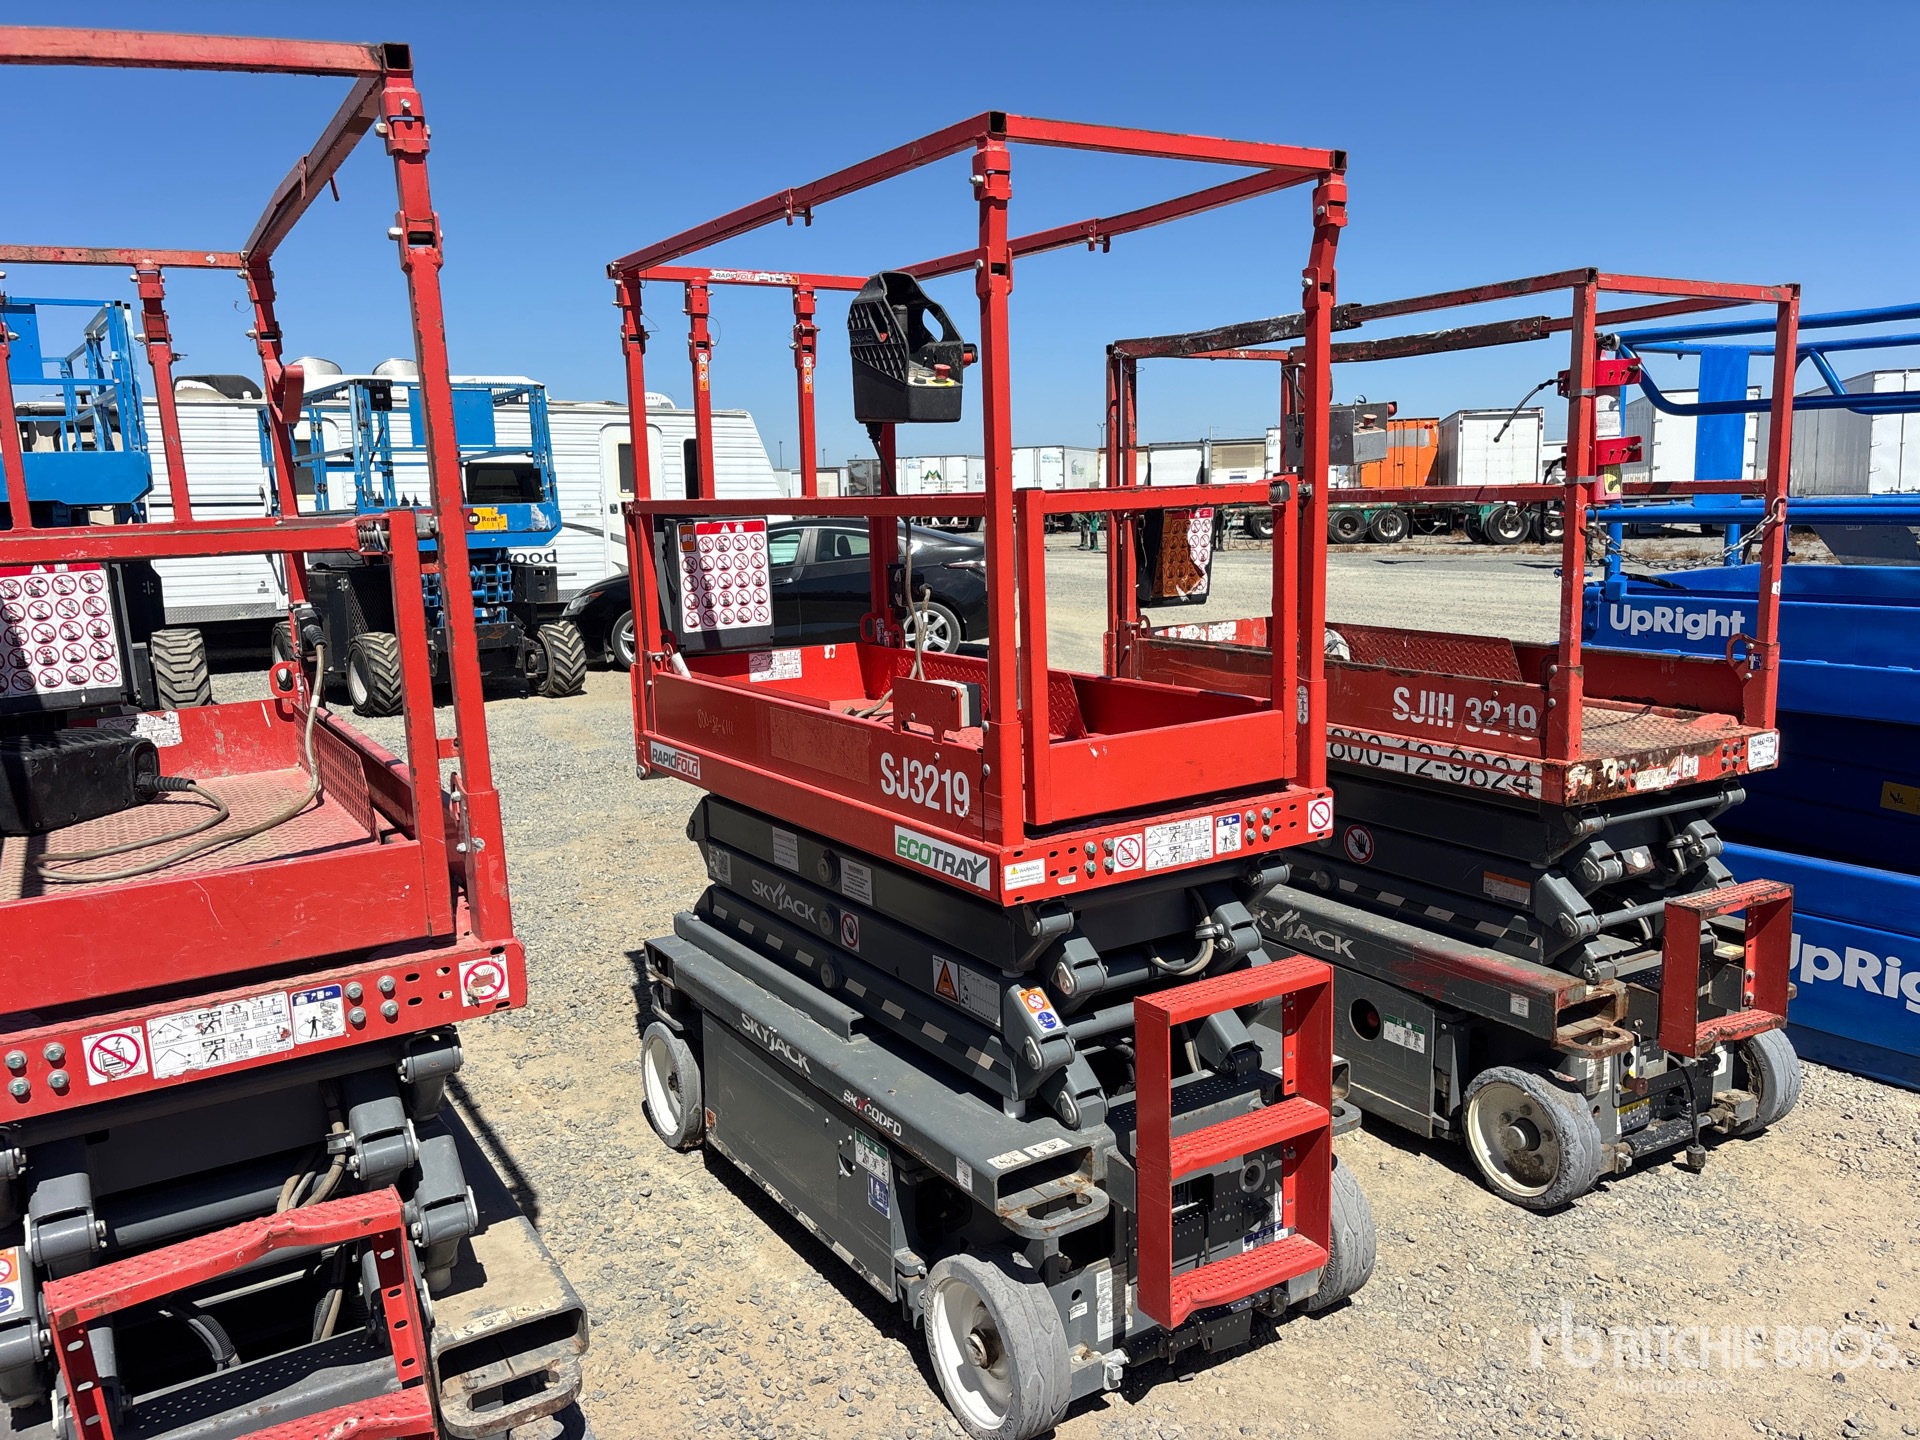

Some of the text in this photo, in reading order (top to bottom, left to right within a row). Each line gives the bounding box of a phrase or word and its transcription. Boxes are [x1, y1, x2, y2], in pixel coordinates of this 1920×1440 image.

[510, 549, 559, 564] ood
[1609, 603, 1746, 641] UpRight
[1465, 696, 1538, 742] 3219
[880, 751, 971, 818] SJ3219
[896, 833, 989, 884] ECOTRAY
[751, 878, 818, 925] SKYJACK
[741, 1012, 812, 1075] SKYJACK
